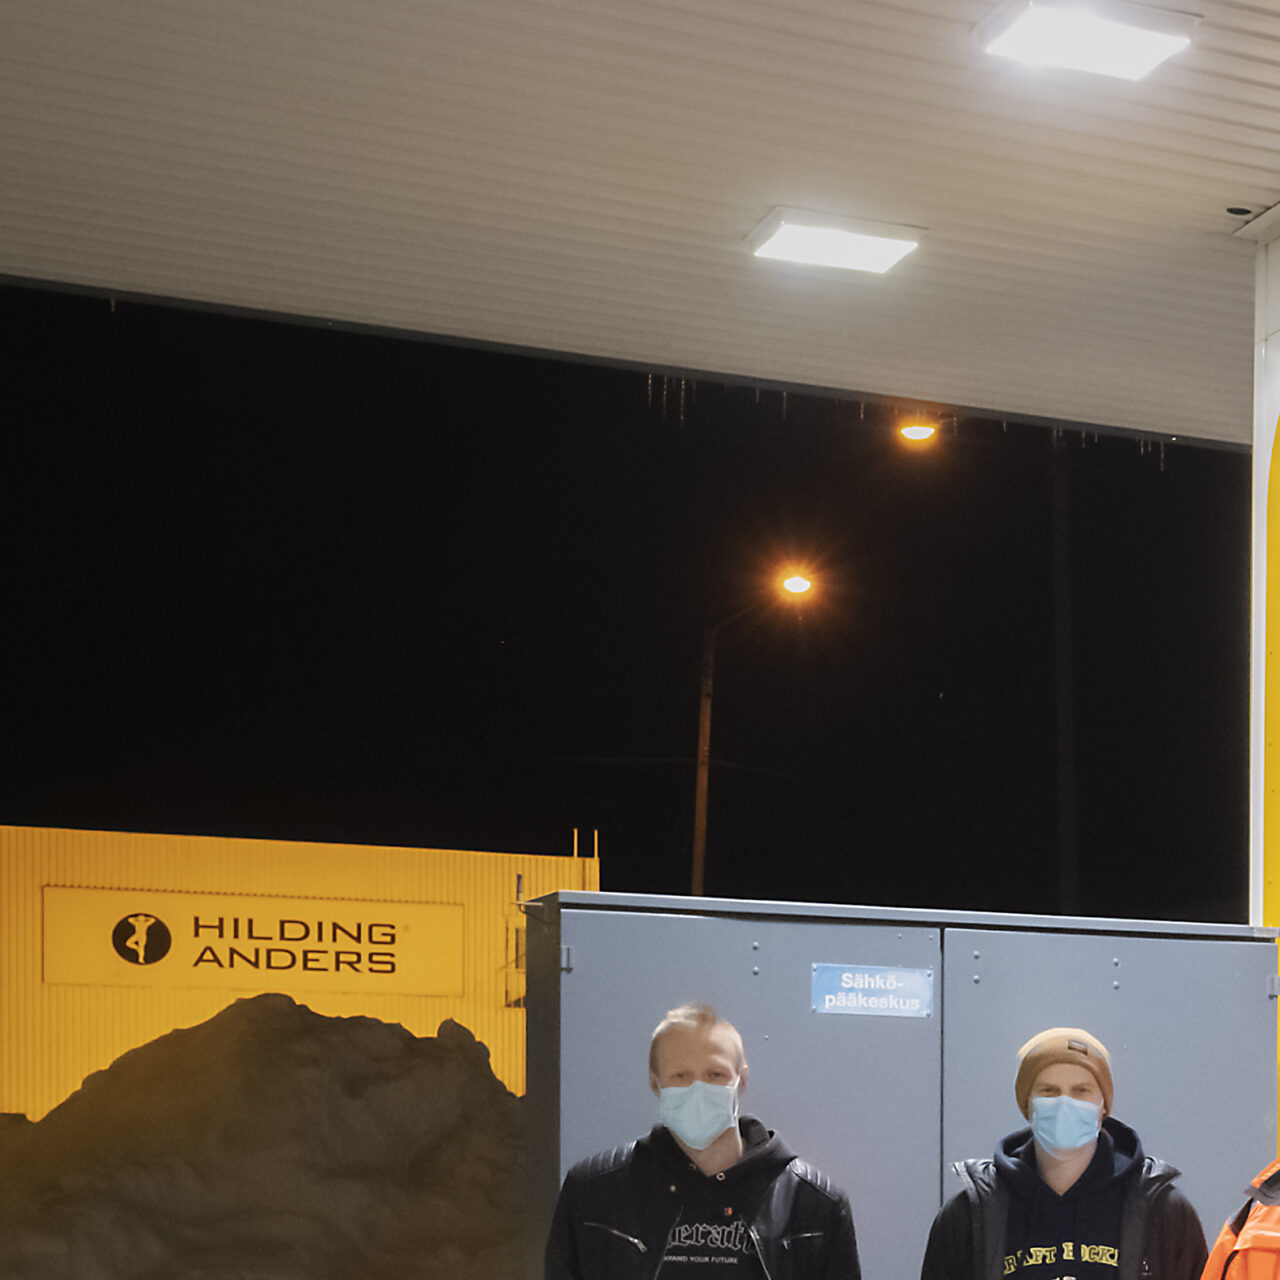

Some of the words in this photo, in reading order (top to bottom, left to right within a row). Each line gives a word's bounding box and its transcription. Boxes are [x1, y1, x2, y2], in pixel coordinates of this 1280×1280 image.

[193, 915, 397, 945] HILDING
[192, 945, 397, 974] ANDERS
[840, 972, 905, 991] Sähkö-
[824, 991, 921, 1011] pääkeskus
